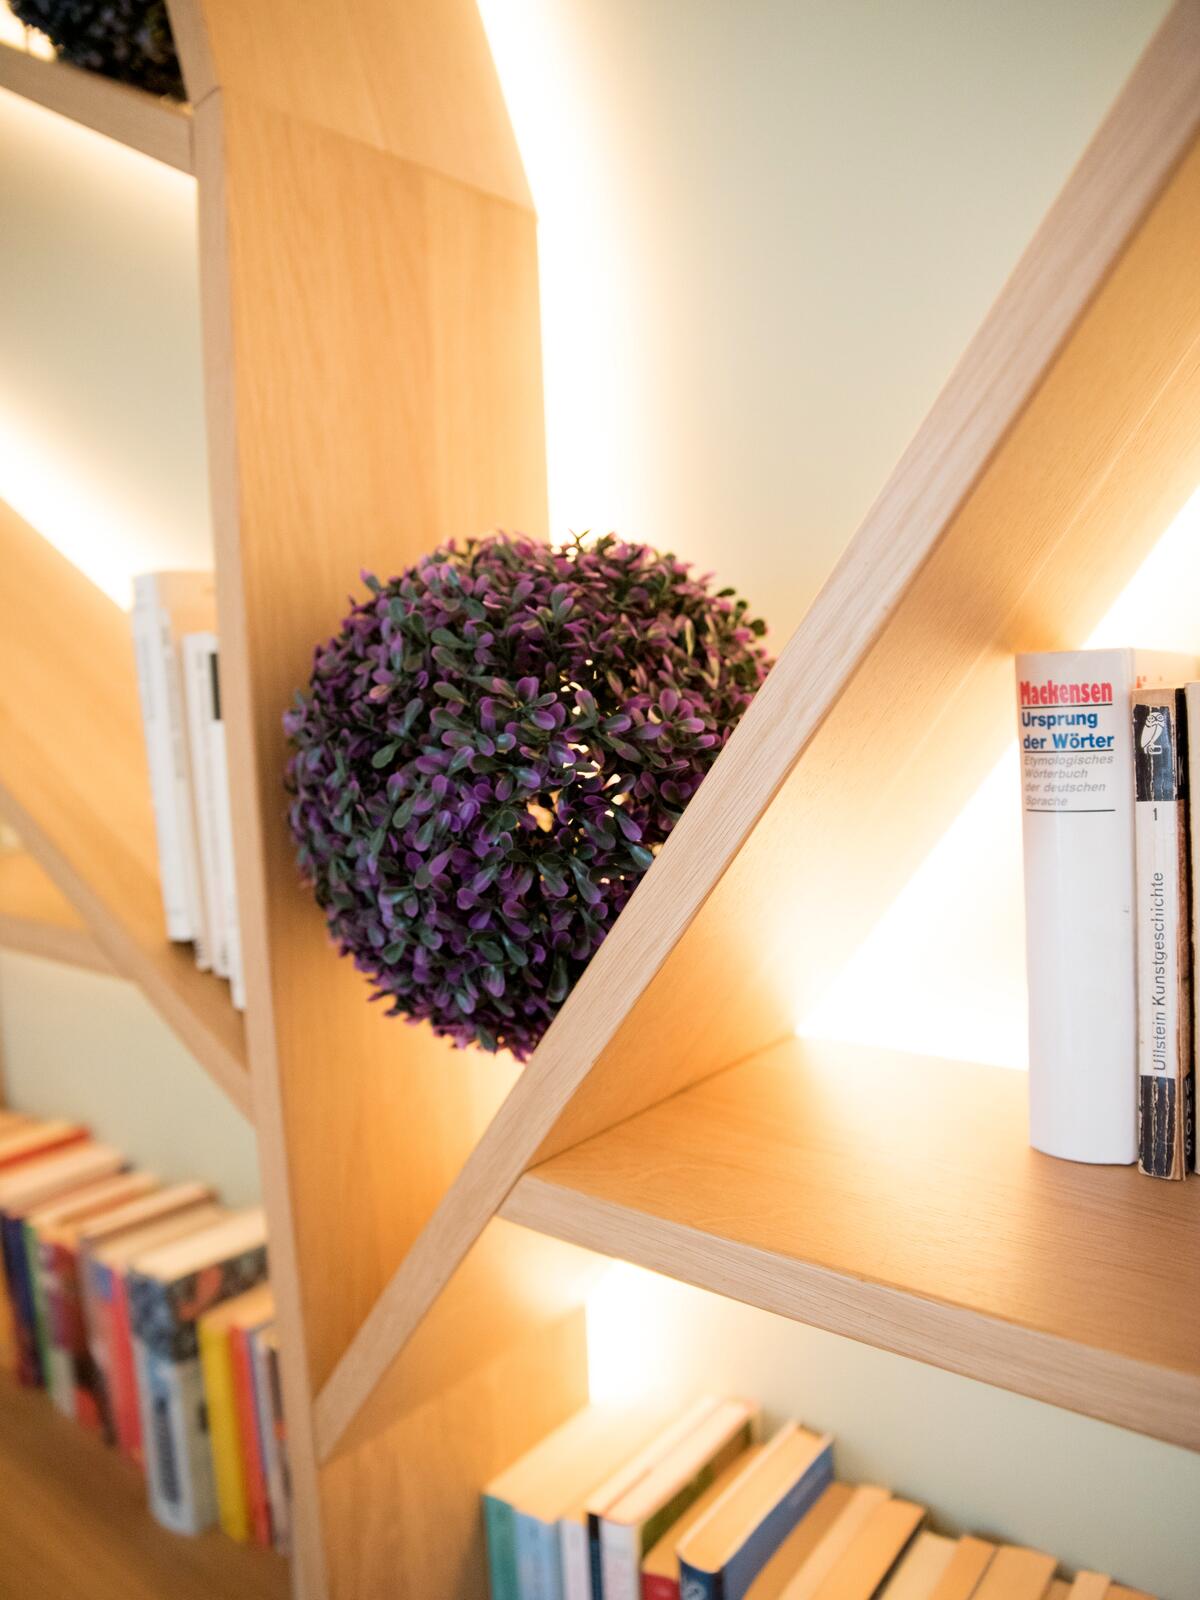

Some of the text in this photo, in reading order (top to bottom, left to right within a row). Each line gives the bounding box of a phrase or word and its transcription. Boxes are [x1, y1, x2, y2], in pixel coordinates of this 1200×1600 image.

[1020, 680, 1113, 705] Mackensen
[1022, 712, 1098, 729] Ursprung
[1023, 733, 1115, 749] der Wörter
[1024, 755, 1114, 767] Etymologisches
[1043, 783, 1106, 793] deutschen
[1150, 872, 1168, 1071] Ullstein Kunstgeschichte
